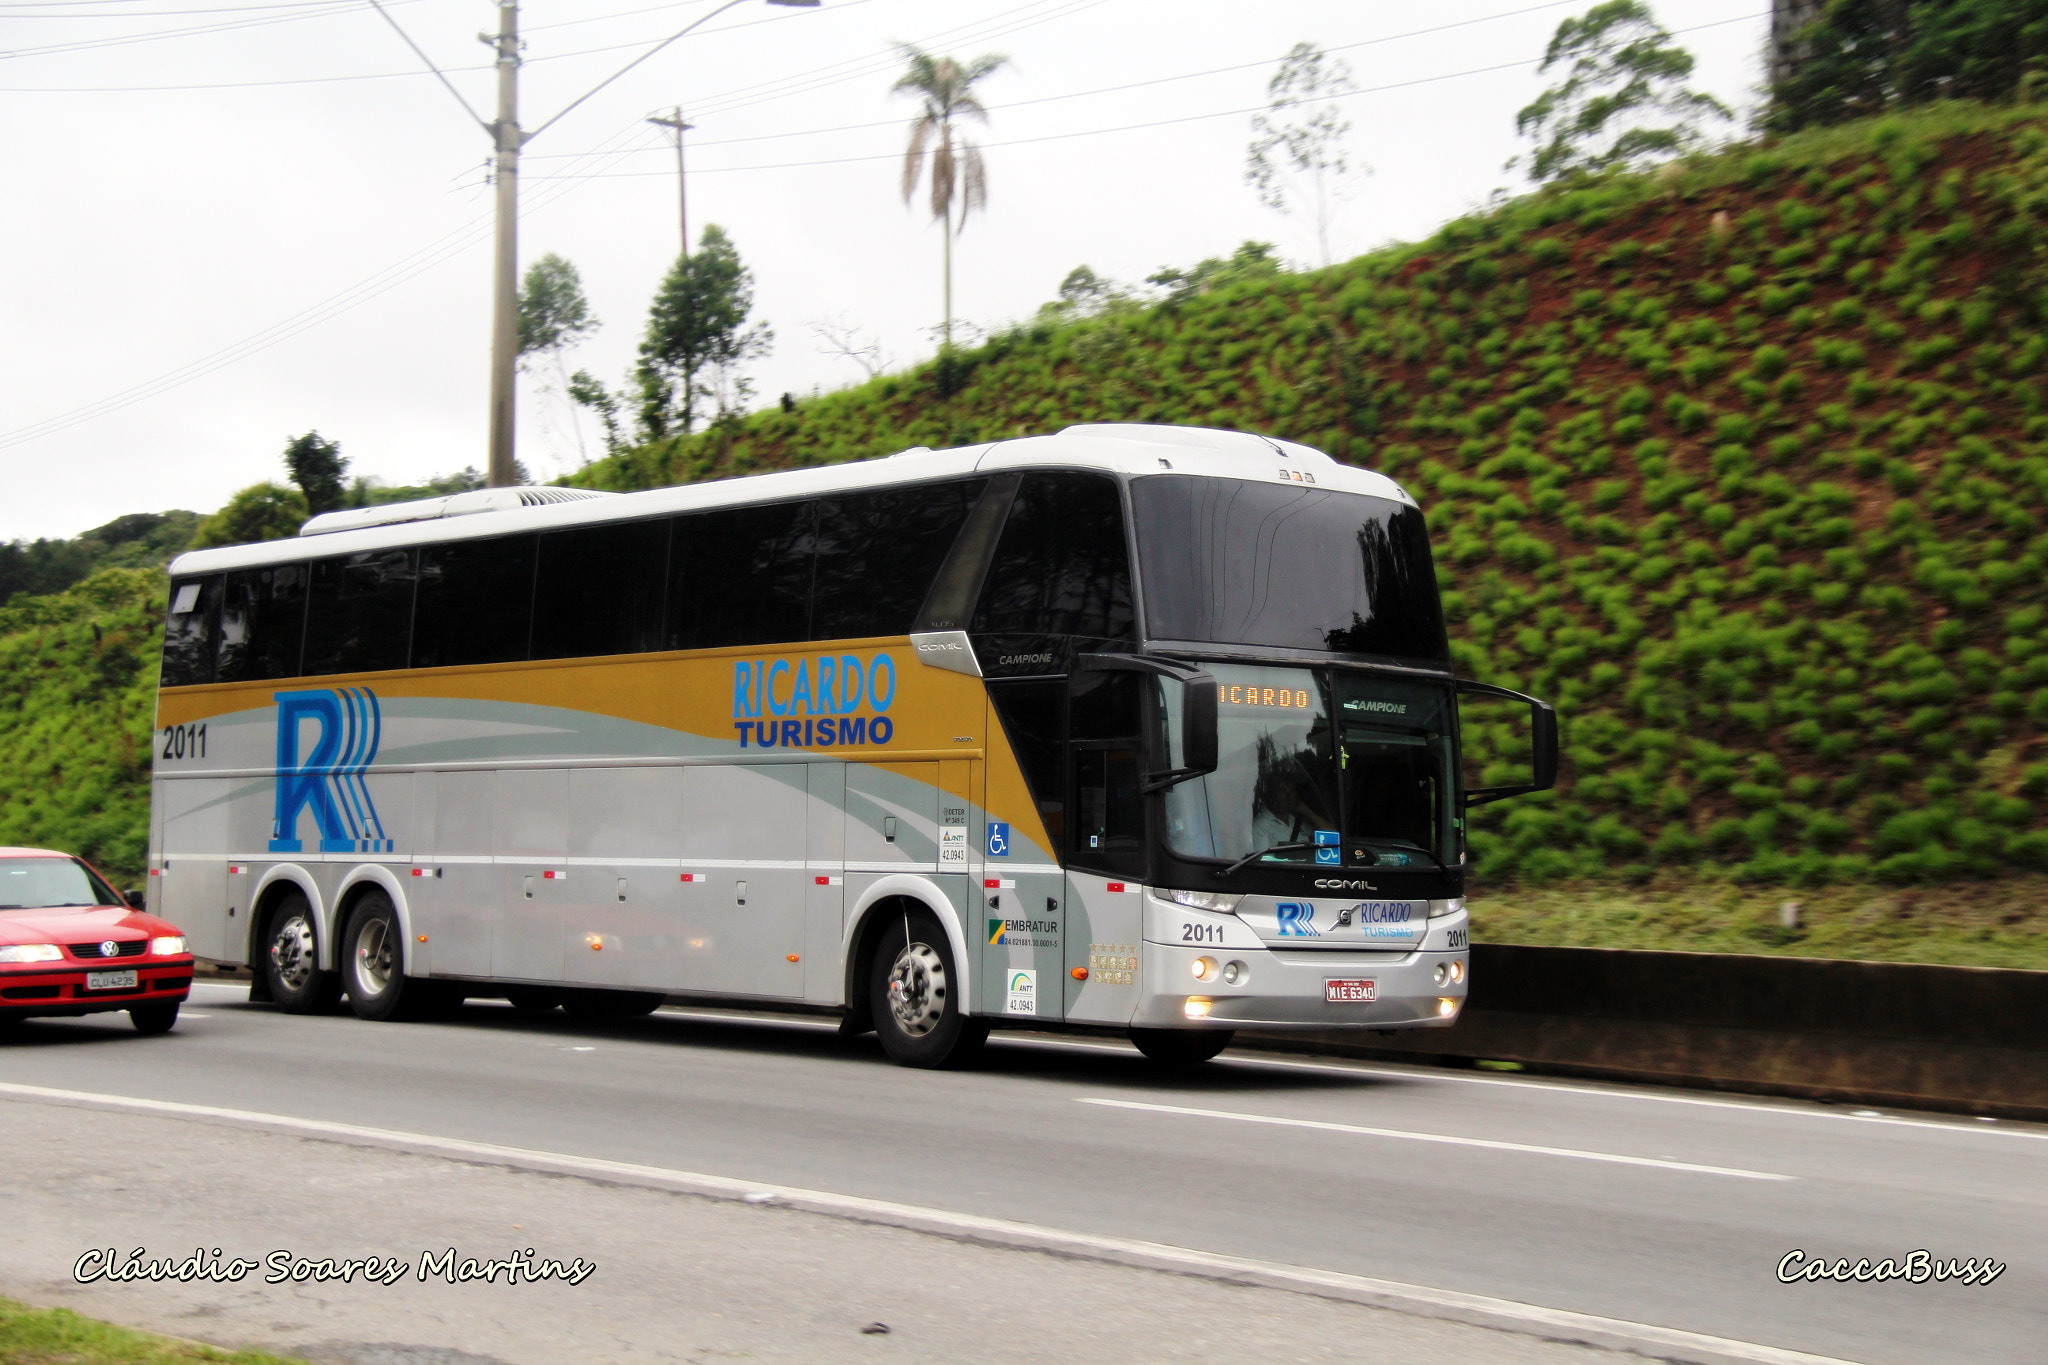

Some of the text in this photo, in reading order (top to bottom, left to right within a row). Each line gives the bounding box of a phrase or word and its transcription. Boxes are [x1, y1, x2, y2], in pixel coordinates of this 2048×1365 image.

[918, 642, 963, 652] COMIL
[999, 653, 1053, 665] CAMPIONE
[732, 653, 896, 719] RICARDO
[1219, 684, 1308, 708] ICARDO
[163, 723, 207, 760] 2011
[734, 716, 894, 748] TURISMO
[950, 834, 964, 842] ANTT
[1314, 878, 1378, 891] COMIL
[1361, 902, 1412, 924] RICARDO
[1005, 919, 1058, 933] EMBRATUR
[1182, 923, 1224, 943] 2011
[1362, 926, 1414, 938] TURISMO
[1447, 929, 1468, 948] 2011
